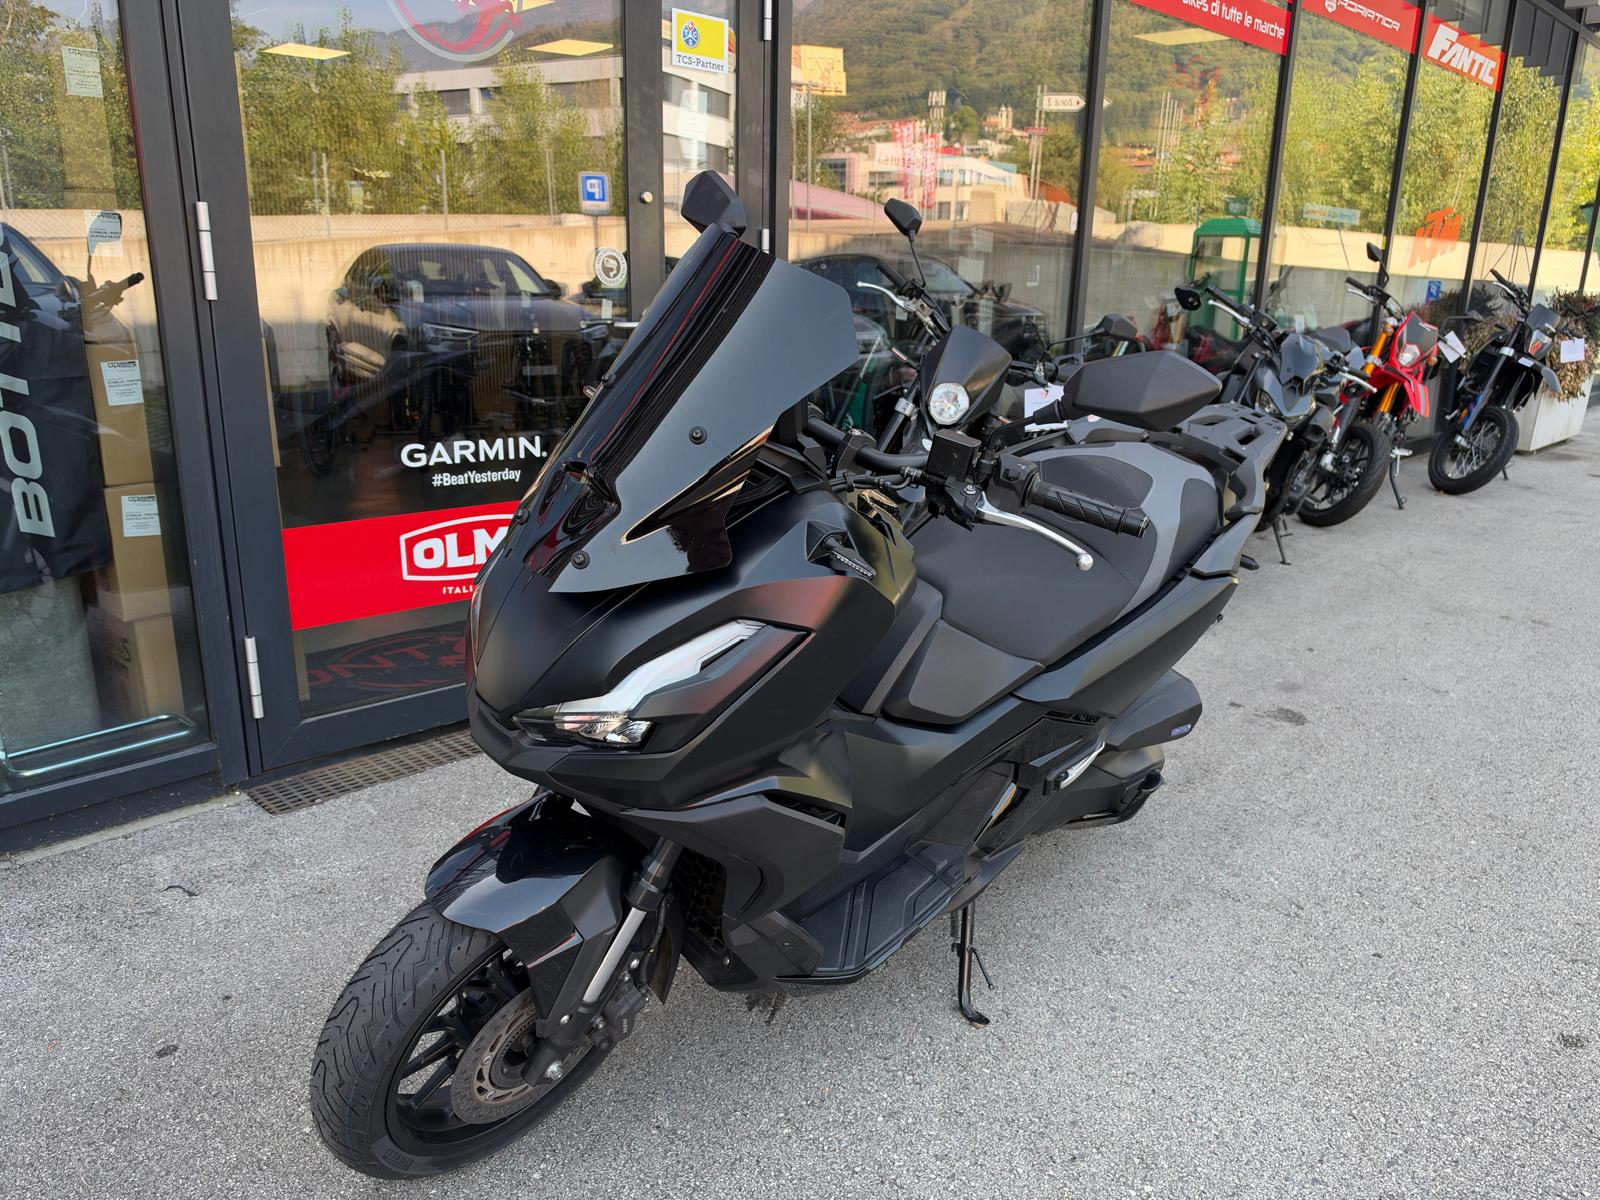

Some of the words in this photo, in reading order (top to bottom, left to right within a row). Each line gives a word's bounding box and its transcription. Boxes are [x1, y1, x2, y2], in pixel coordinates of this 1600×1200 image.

[1211, 0, 1220, 17] di
[1221, 3, 1242, 24] tutte
[1244, 11, 1251, 28] le
[1254, 18, 1285, 40] marche
[676, 54, 725, 71] TCS-Partner
[1427, 24, 1497, 85] FANTIC
[1408, 207, 1463, 269] KTM
[431, 468, 521, 487] #BeatYesterday
[412, 526, 509, 569] OLM
[442, 585, 474, 595] ITALI
